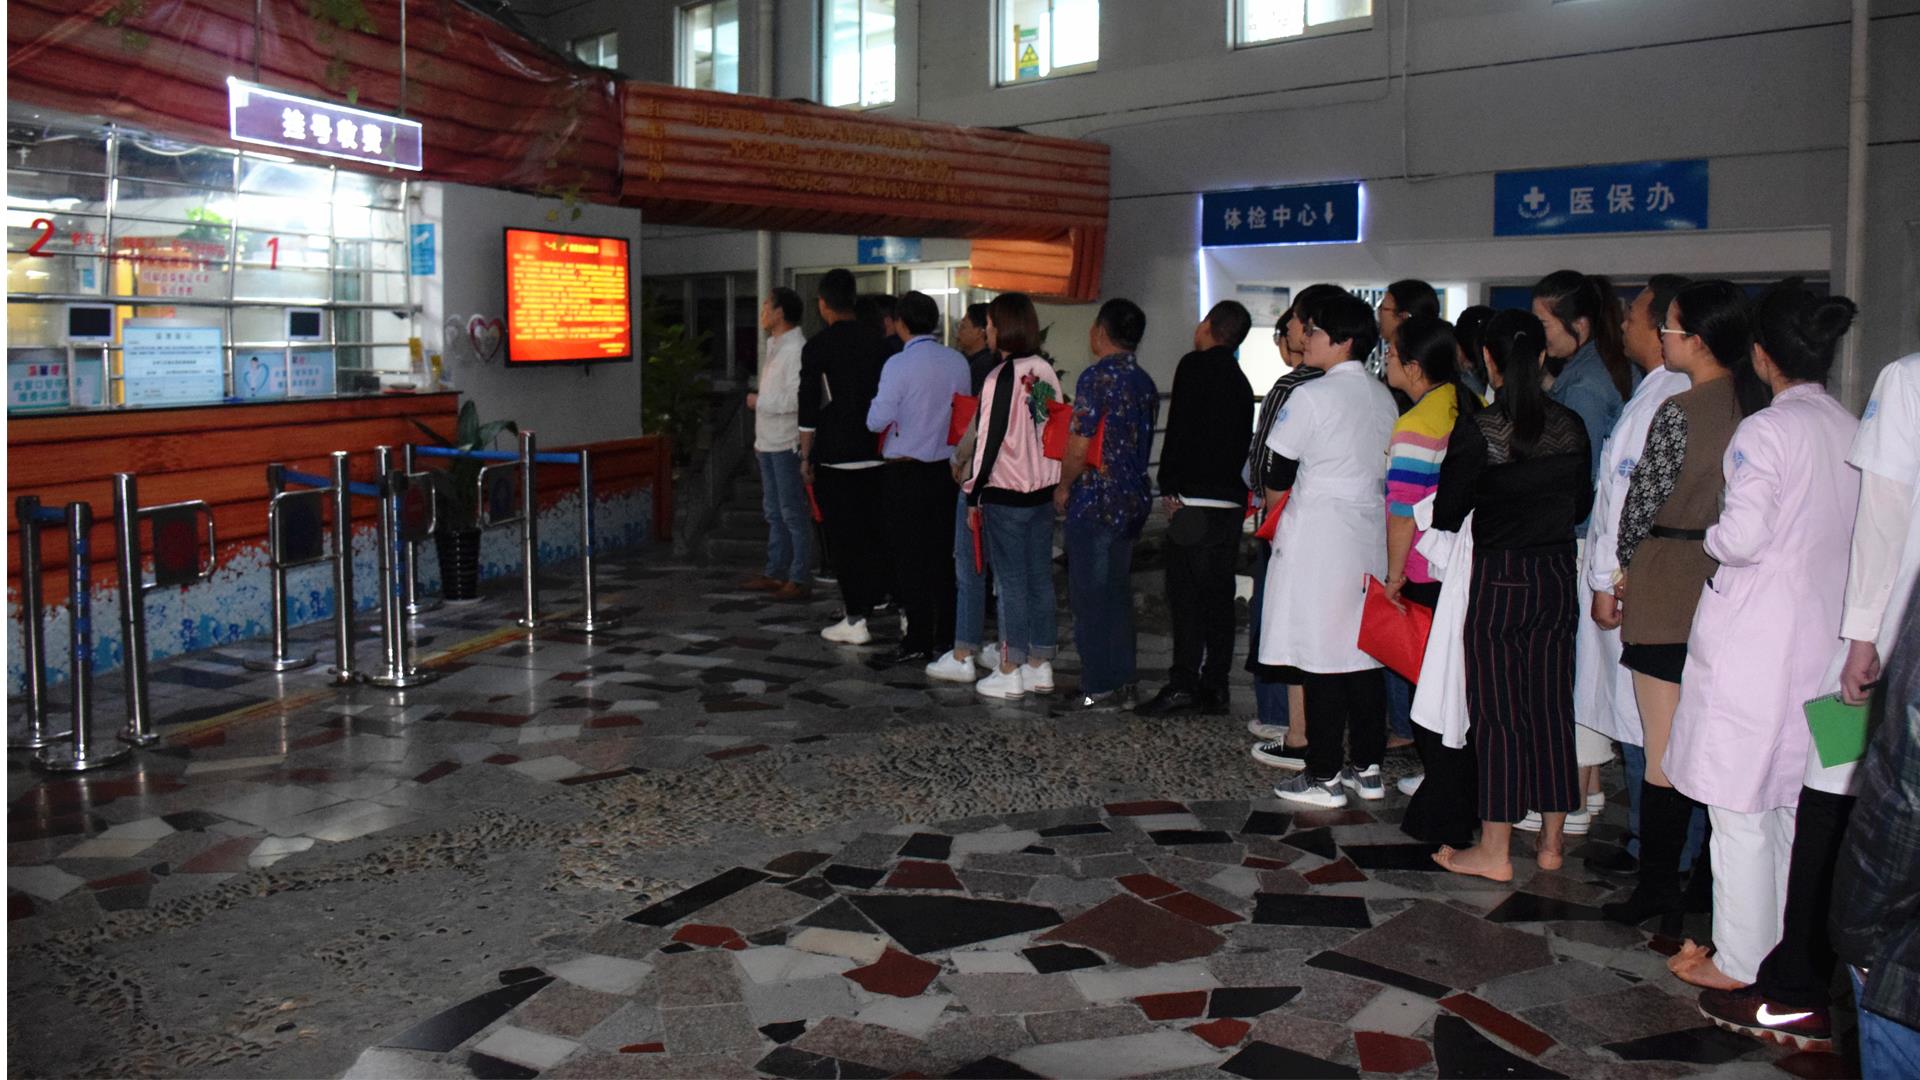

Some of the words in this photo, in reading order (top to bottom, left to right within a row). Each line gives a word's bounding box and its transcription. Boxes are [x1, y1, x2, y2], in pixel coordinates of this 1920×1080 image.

[282, 107, 382, 154] 挂号收费
[1569, 182, 1675, 215] 医保办
[1224, 203, 1318, 231] 体检中心
[28, 218, 55, 257] 2
[267, 236, 279, 270] 1
